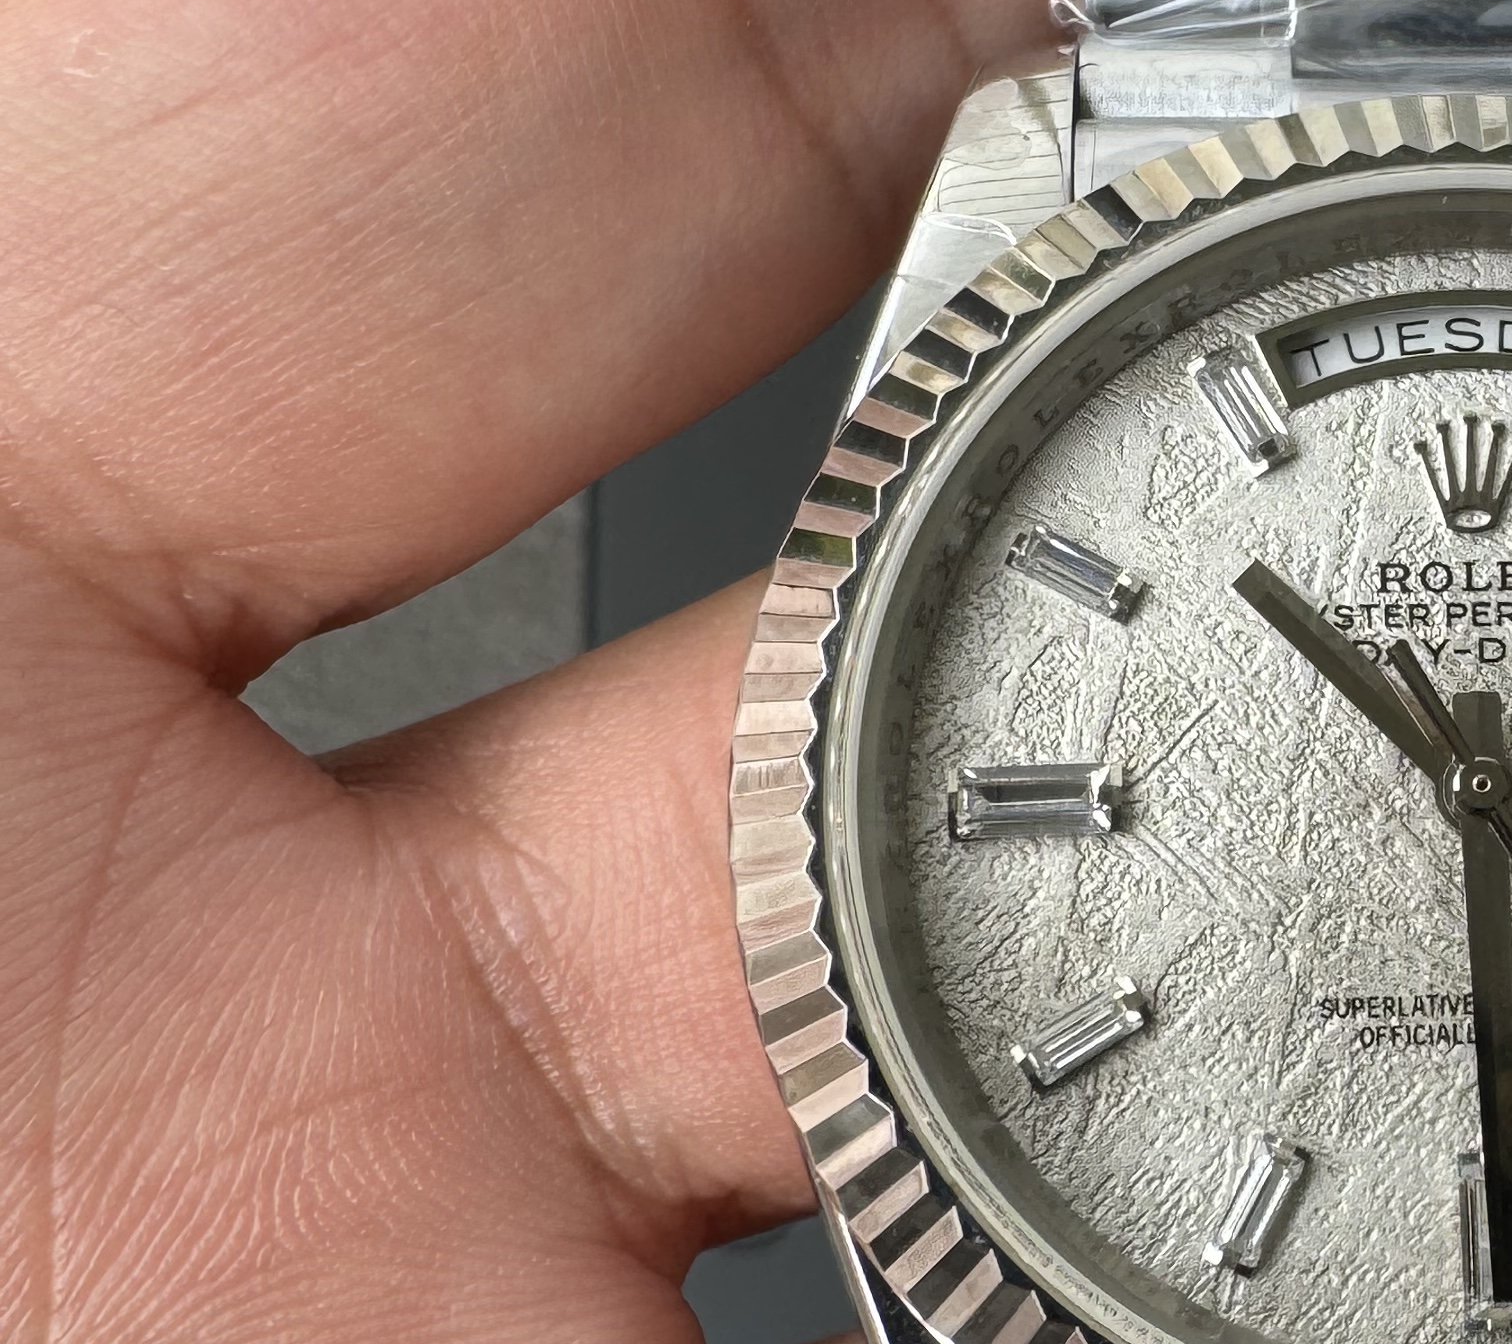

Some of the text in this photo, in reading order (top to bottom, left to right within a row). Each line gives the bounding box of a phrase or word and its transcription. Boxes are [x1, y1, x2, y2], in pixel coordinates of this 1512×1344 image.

[1318, 604, 1430, 631] STER
[1319, 991, 1475, 1020] SUPERLATIVE
[1359, 1022, 1476, 1049] OFFICIALL
